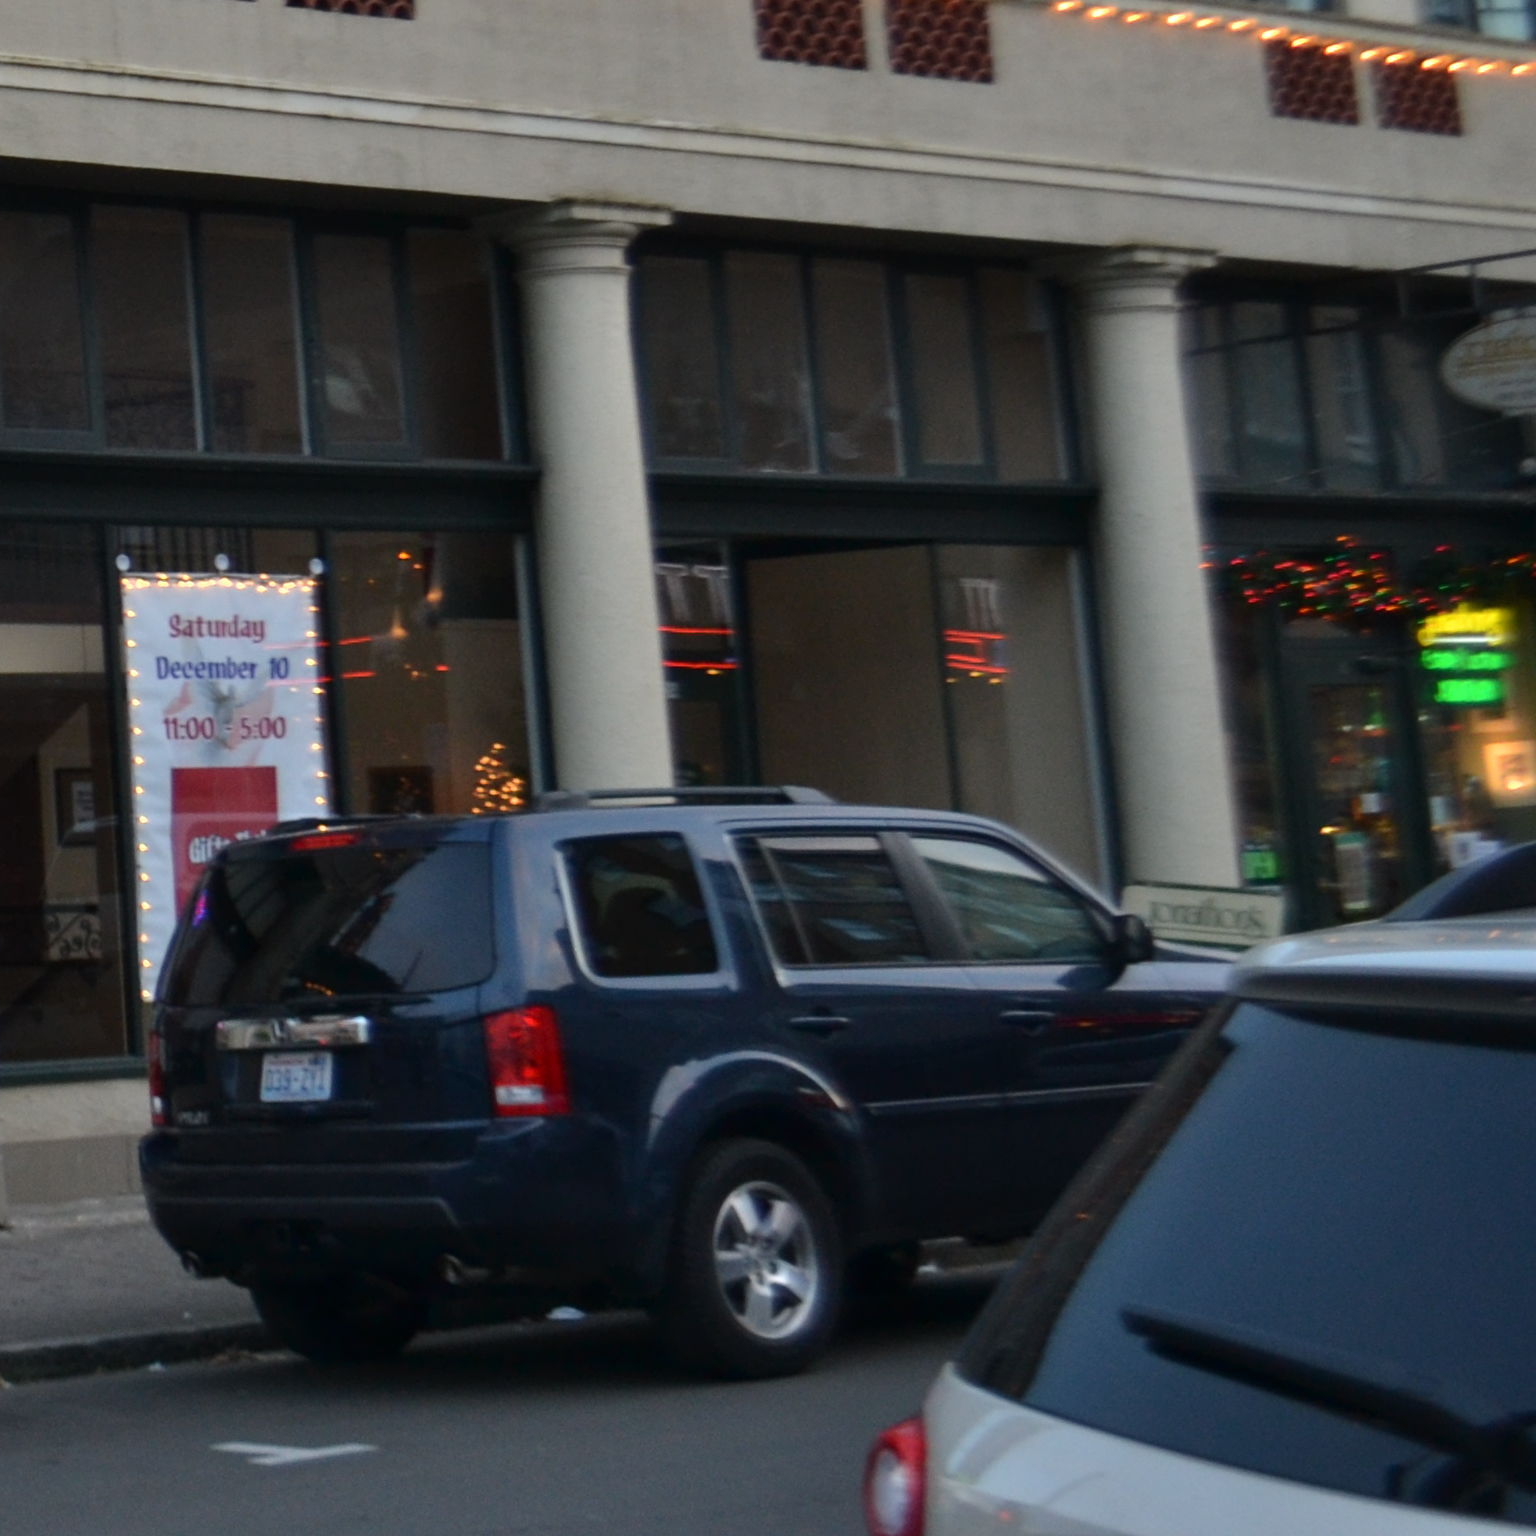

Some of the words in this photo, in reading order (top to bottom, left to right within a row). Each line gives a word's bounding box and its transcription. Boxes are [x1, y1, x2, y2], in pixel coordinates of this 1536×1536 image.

[169, 614, 266, 643] Saturday
[155, 656, 258, 680] December
[269, 656, 291, 680] 10
[163, 716, 215, 741] 11:00
[240, 716, 288, 741] 5:00
[188, 832, 231, 864] Gif
